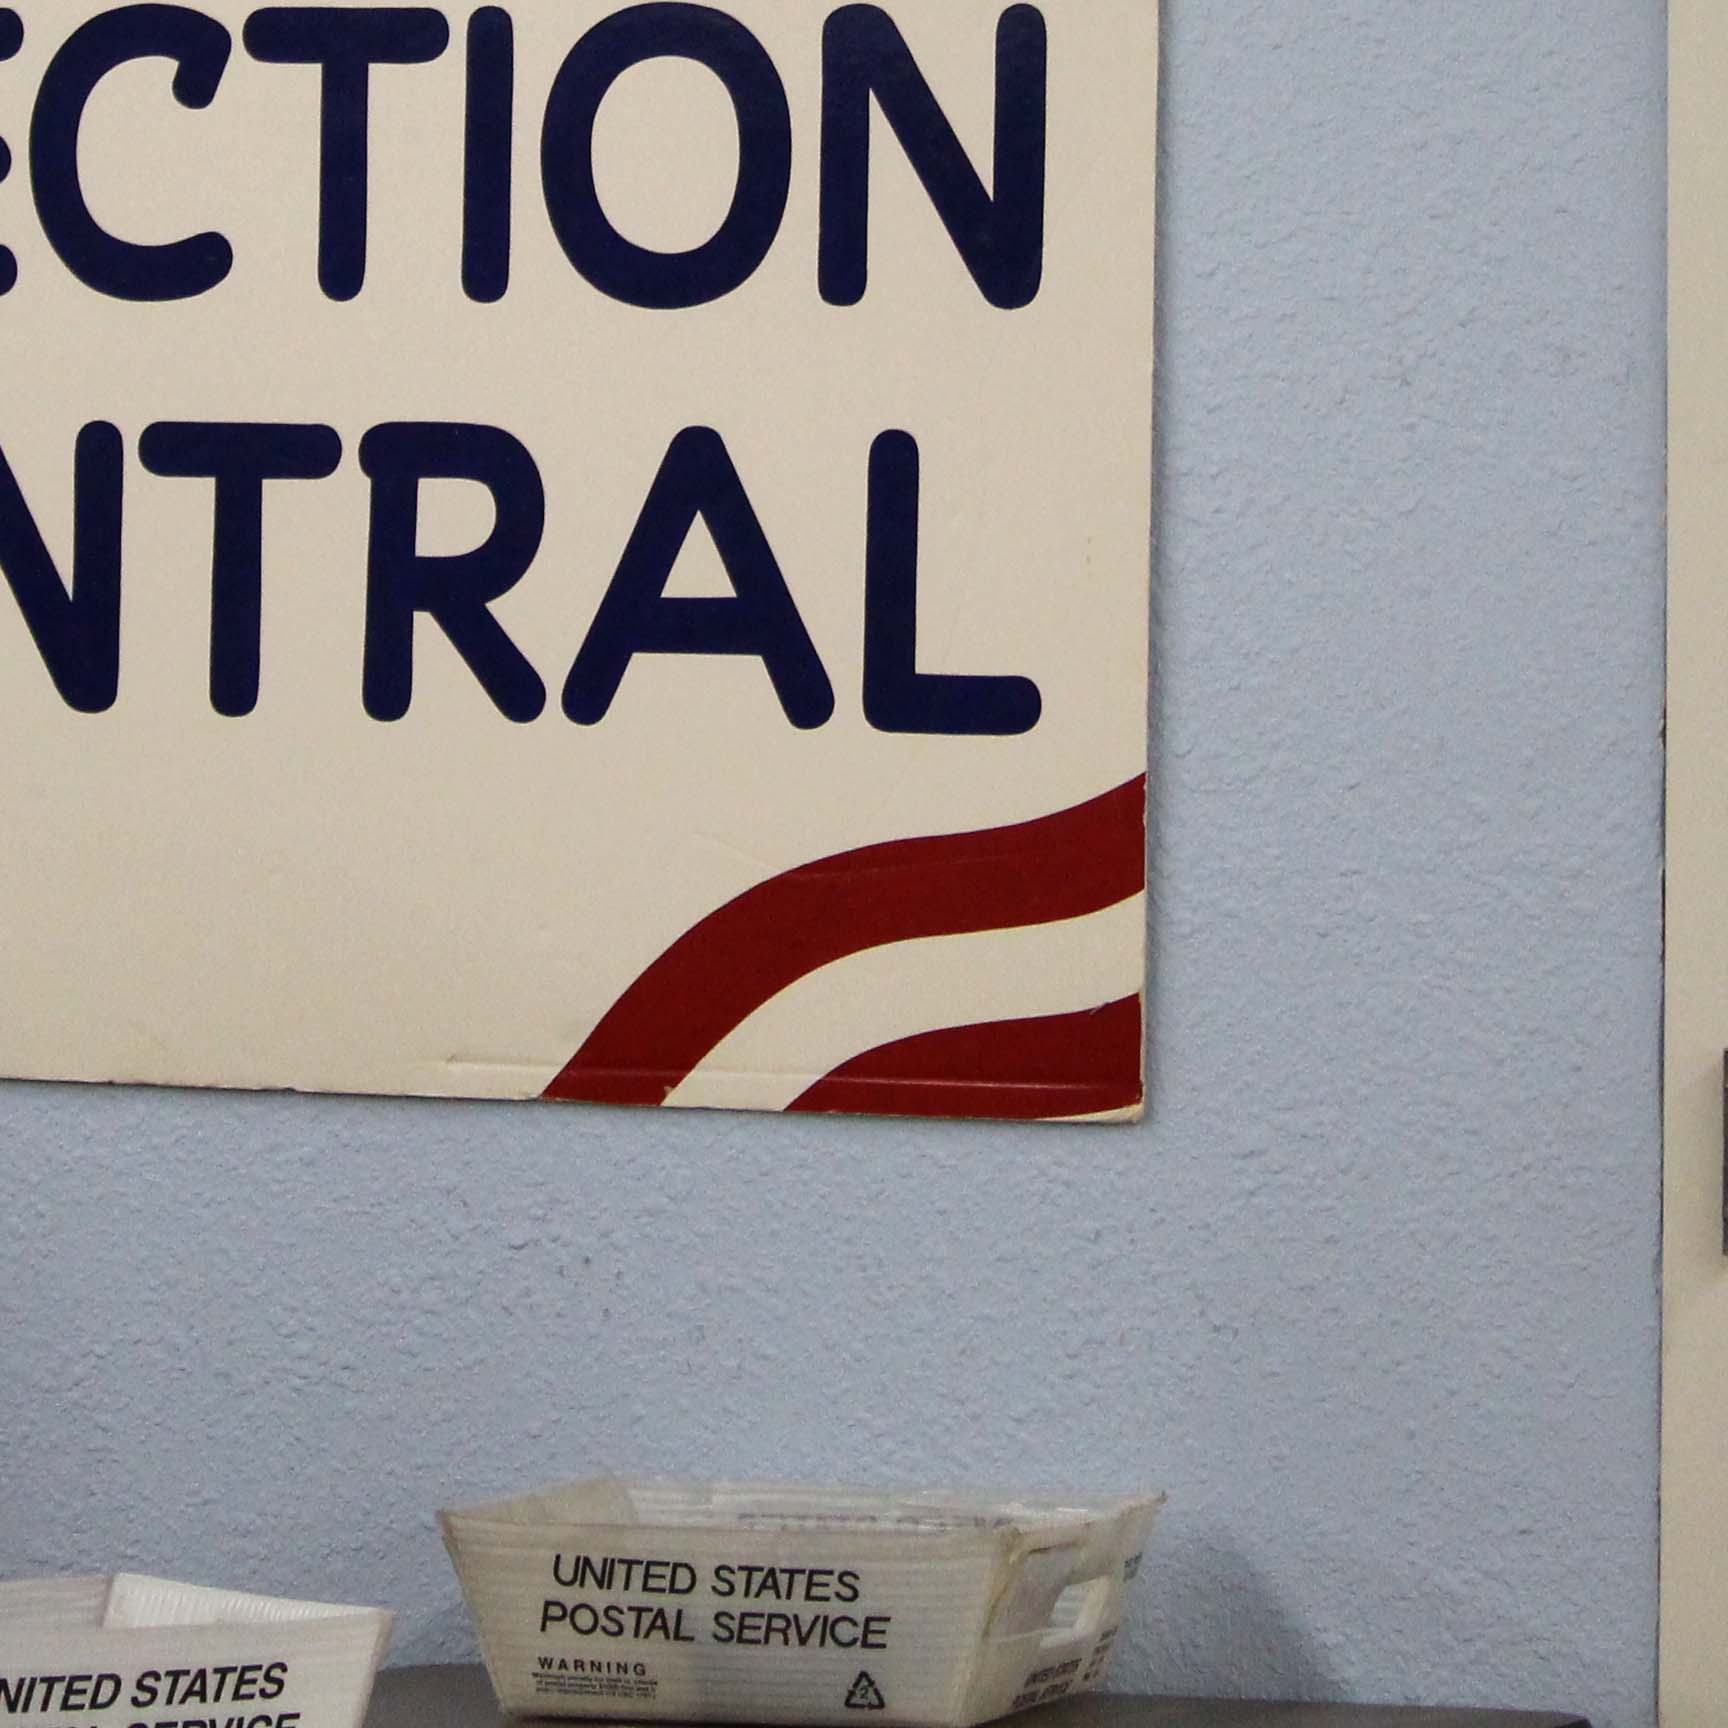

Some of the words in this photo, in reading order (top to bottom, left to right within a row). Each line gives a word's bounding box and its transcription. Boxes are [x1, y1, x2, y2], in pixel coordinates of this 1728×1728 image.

[553, 1553, 698, 1594] UNITED
[710, 1564, 861, 1603] STATES
[539, 1600, 696, 1642] POSTAL
[711, 1610, 892, 1650] SERVICE
[130, 1661, 289, 1708] STATES
[538, 1656, 647, 1676] WARNING
